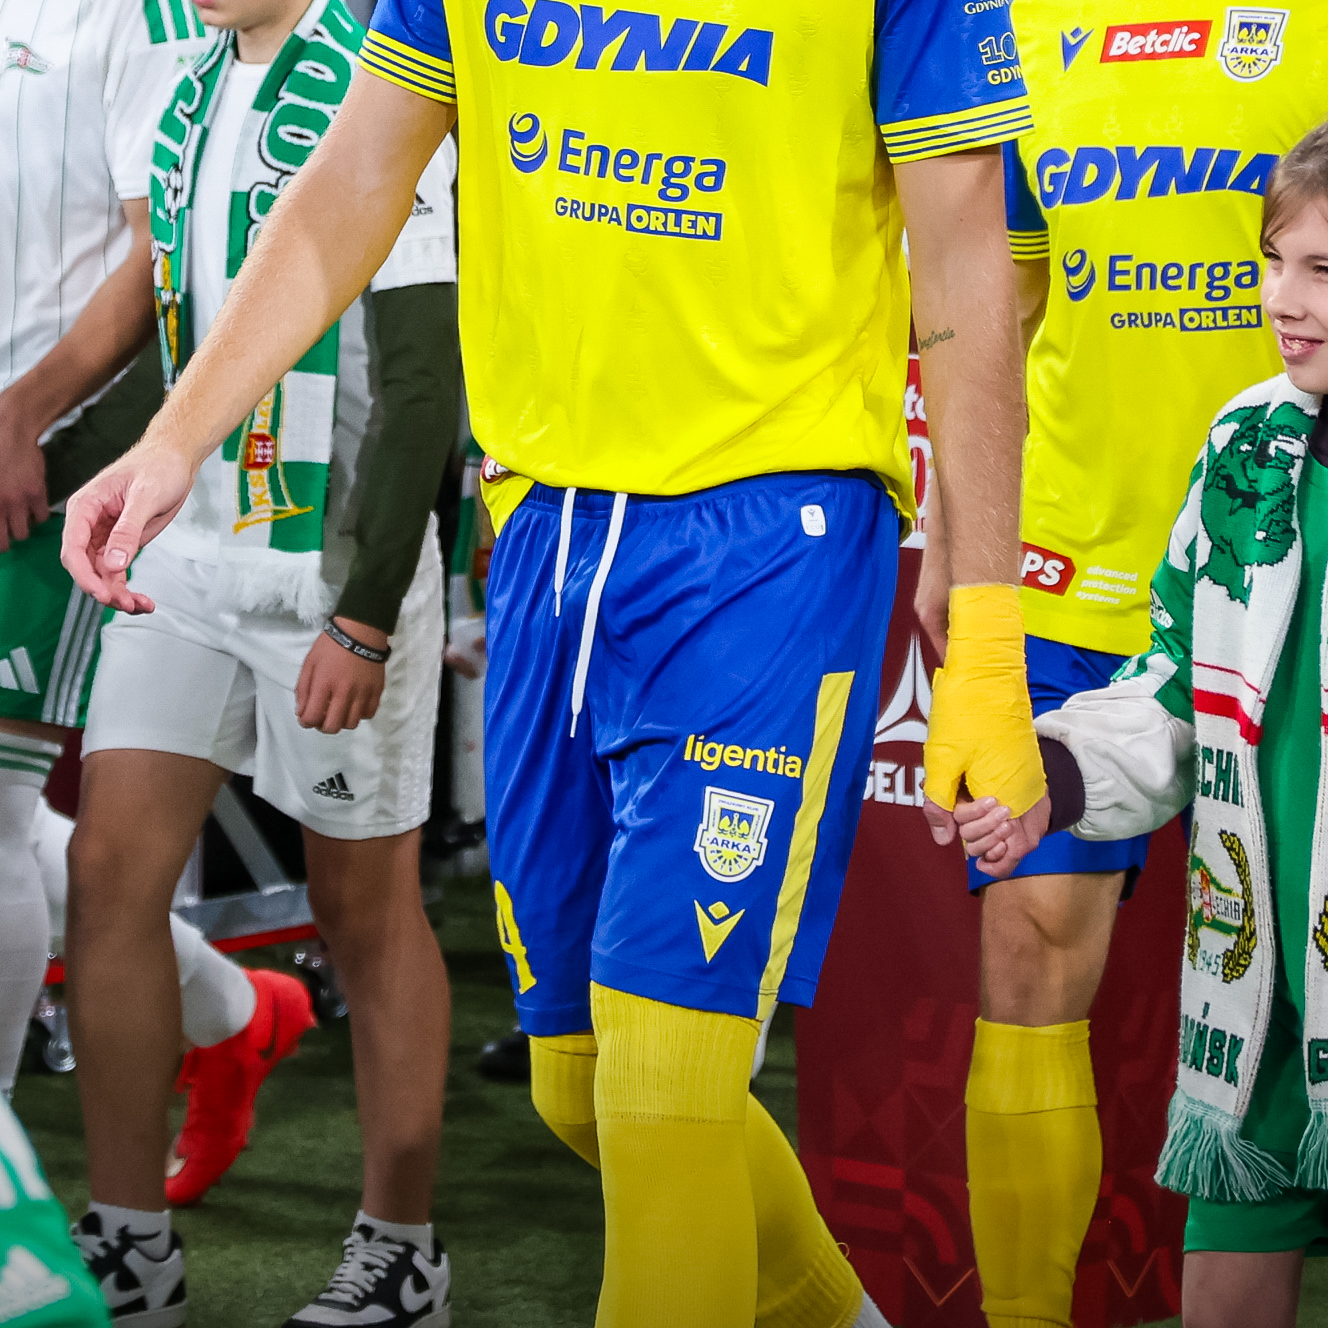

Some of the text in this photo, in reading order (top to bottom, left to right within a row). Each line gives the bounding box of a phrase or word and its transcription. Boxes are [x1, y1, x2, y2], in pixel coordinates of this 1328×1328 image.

[1109, 26, 1201, 57] Betclic
[1230, 47, 1270, 56] ARKA
[558, 128, 727, 202] Energa
[1036, 145, 1281, 210] GDYNIA
[554, 197, 717, 236] GRUPA ORLEN
[1108, 254, 1260, 302] Energa
[1111, 307, 1260, 330] GRUPA ORLEN
[1020, 551, 1066, 586] PS
[1086, 565, 1139, 582] advanced
[1075, 590, 1121, 605] systems
[1080, 579, 1138, 595] protection
[684, 734, 803, 779] ligentia
[312, 785, 355, 802] adidas
[710, 836, 752, 854] ARKA
